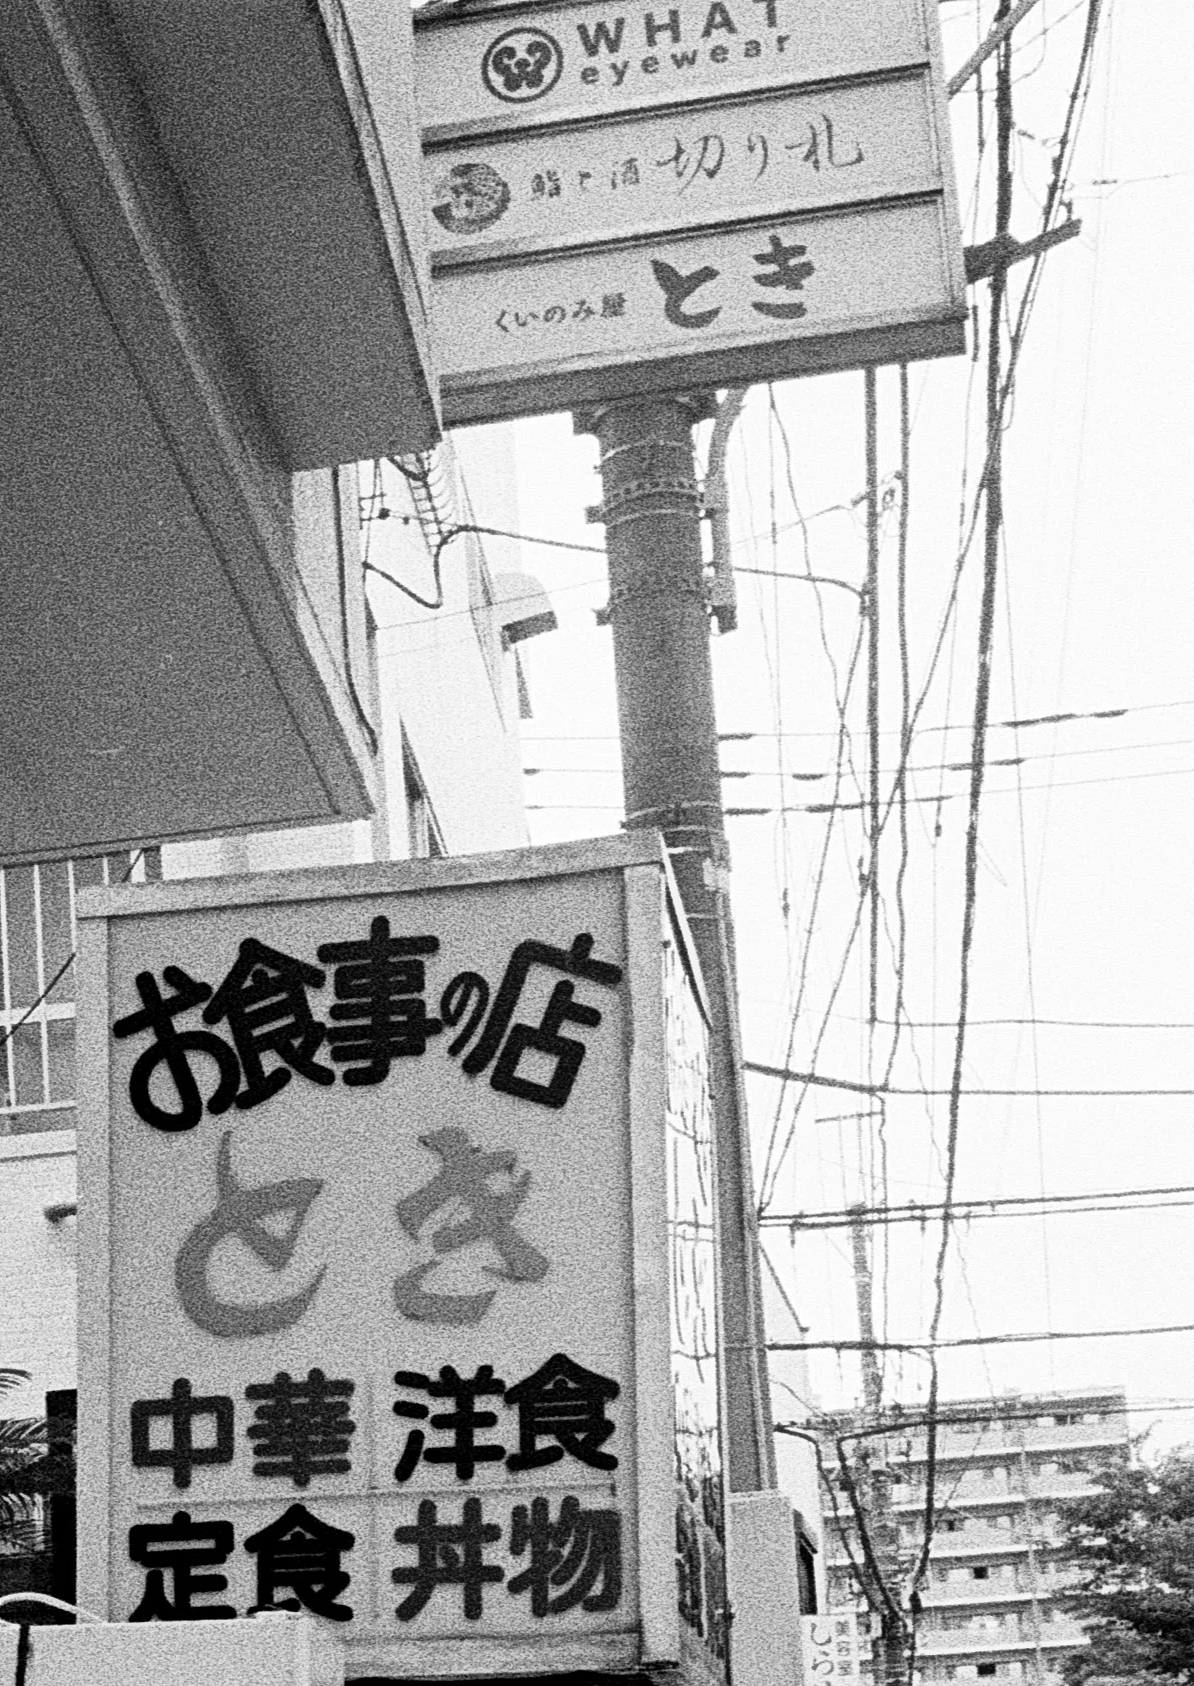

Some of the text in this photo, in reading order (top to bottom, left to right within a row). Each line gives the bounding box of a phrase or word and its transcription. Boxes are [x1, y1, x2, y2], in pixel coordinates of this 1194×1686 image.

[576, 0, 778, 57] WHAT
[581, 32, 791, 87] eyewear
[655, 113, 864, 196] 切り札
[651, 235, 815, 329] とき
[112, 916, 624, 1133] お食事の店
[174, 1126, 550, 1338] とき
[130, 1353, 621, 1489] 中華 洋食
[128, 1496, 623, 1623] 定食 丼物
